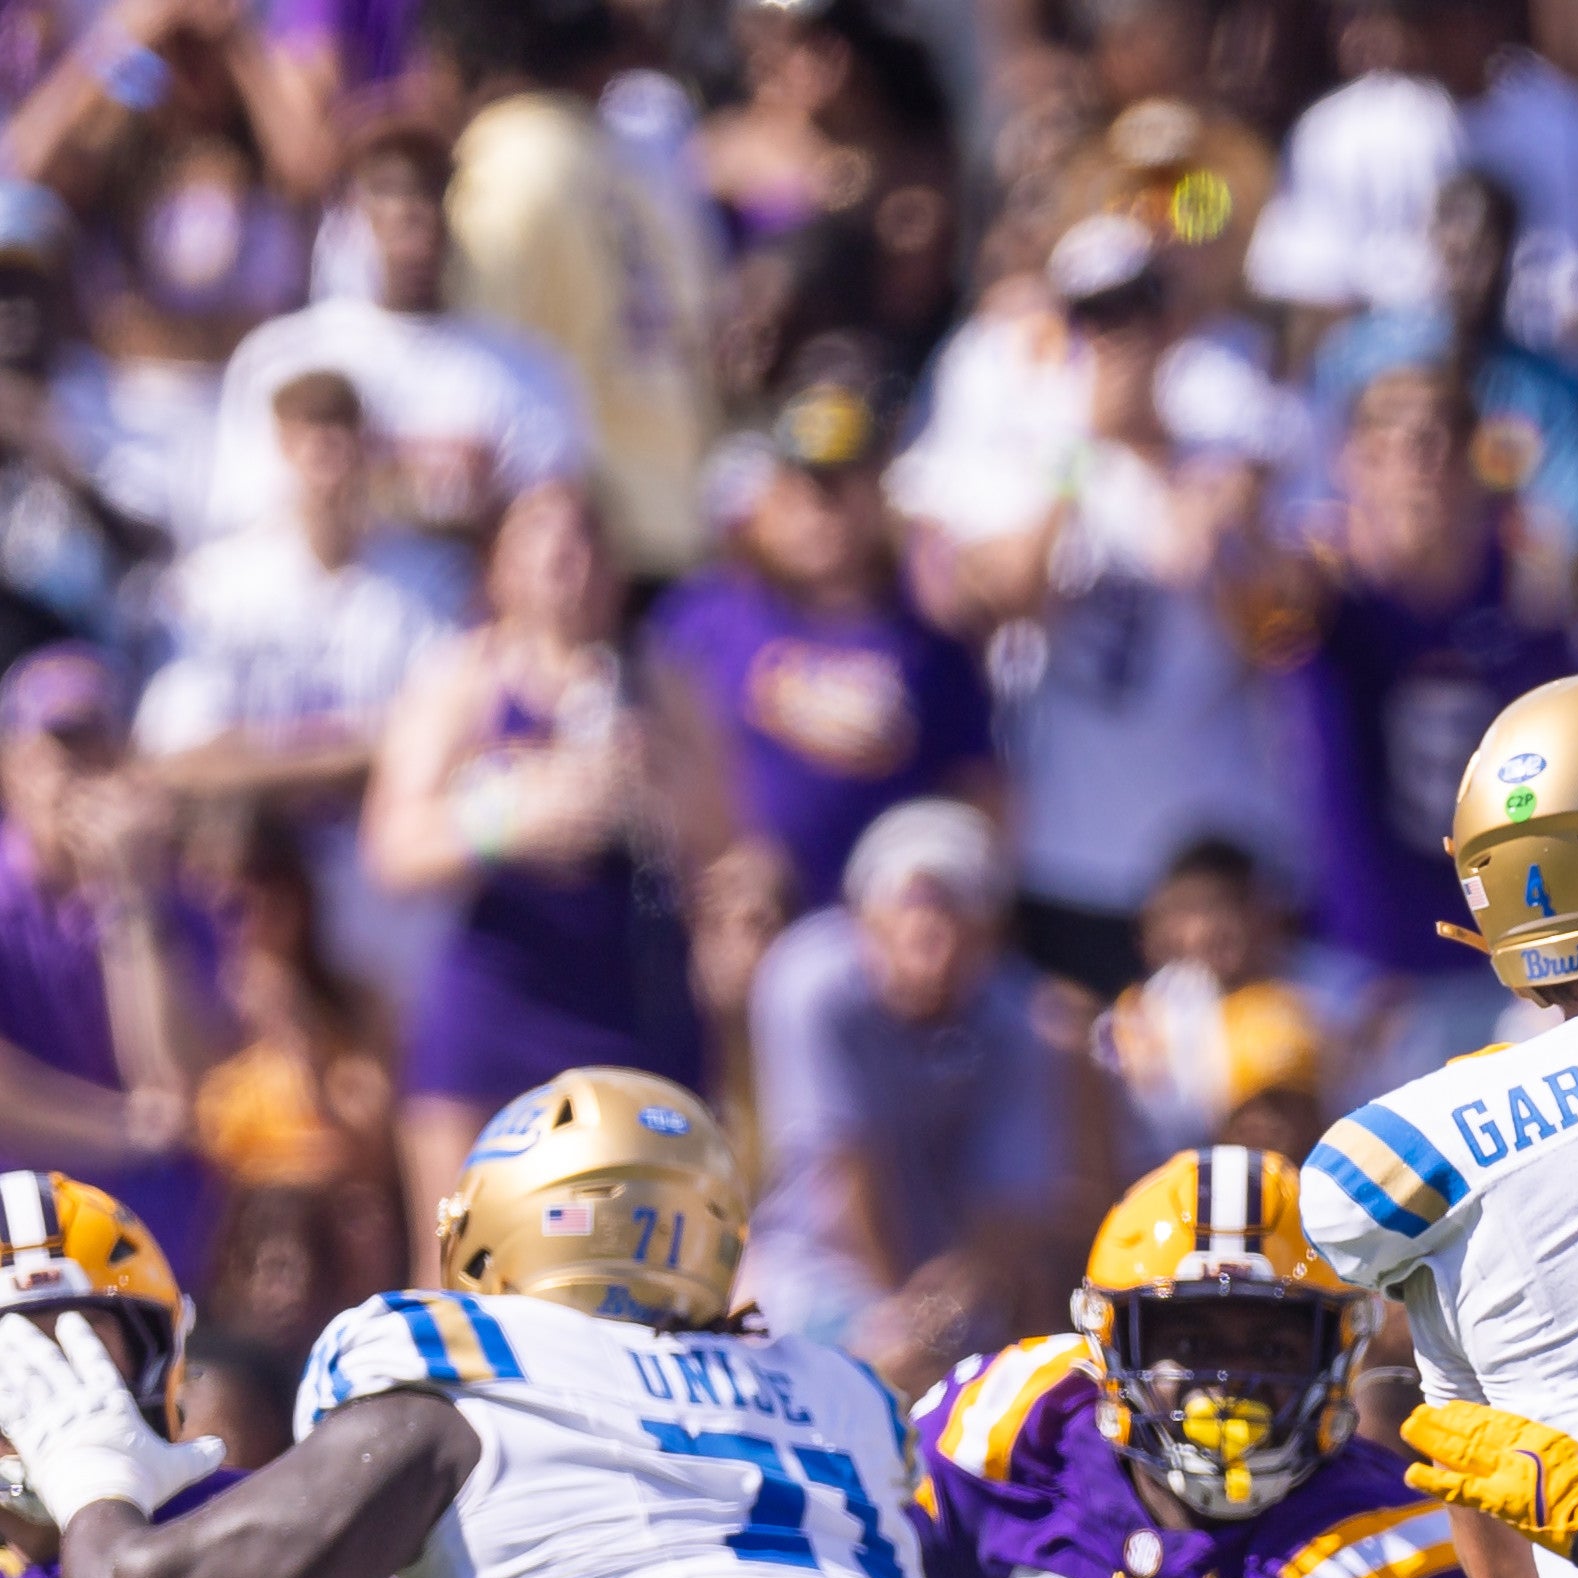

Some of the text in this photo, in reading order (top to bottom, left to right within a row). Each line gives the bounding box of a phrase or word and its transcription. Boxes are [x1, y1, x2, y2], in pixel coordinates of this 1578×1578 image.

[1506, 793, 1534, 809] C2P
[1523, 864, 1556, 918] 4
[632, 1206, 686, 1269] 71
